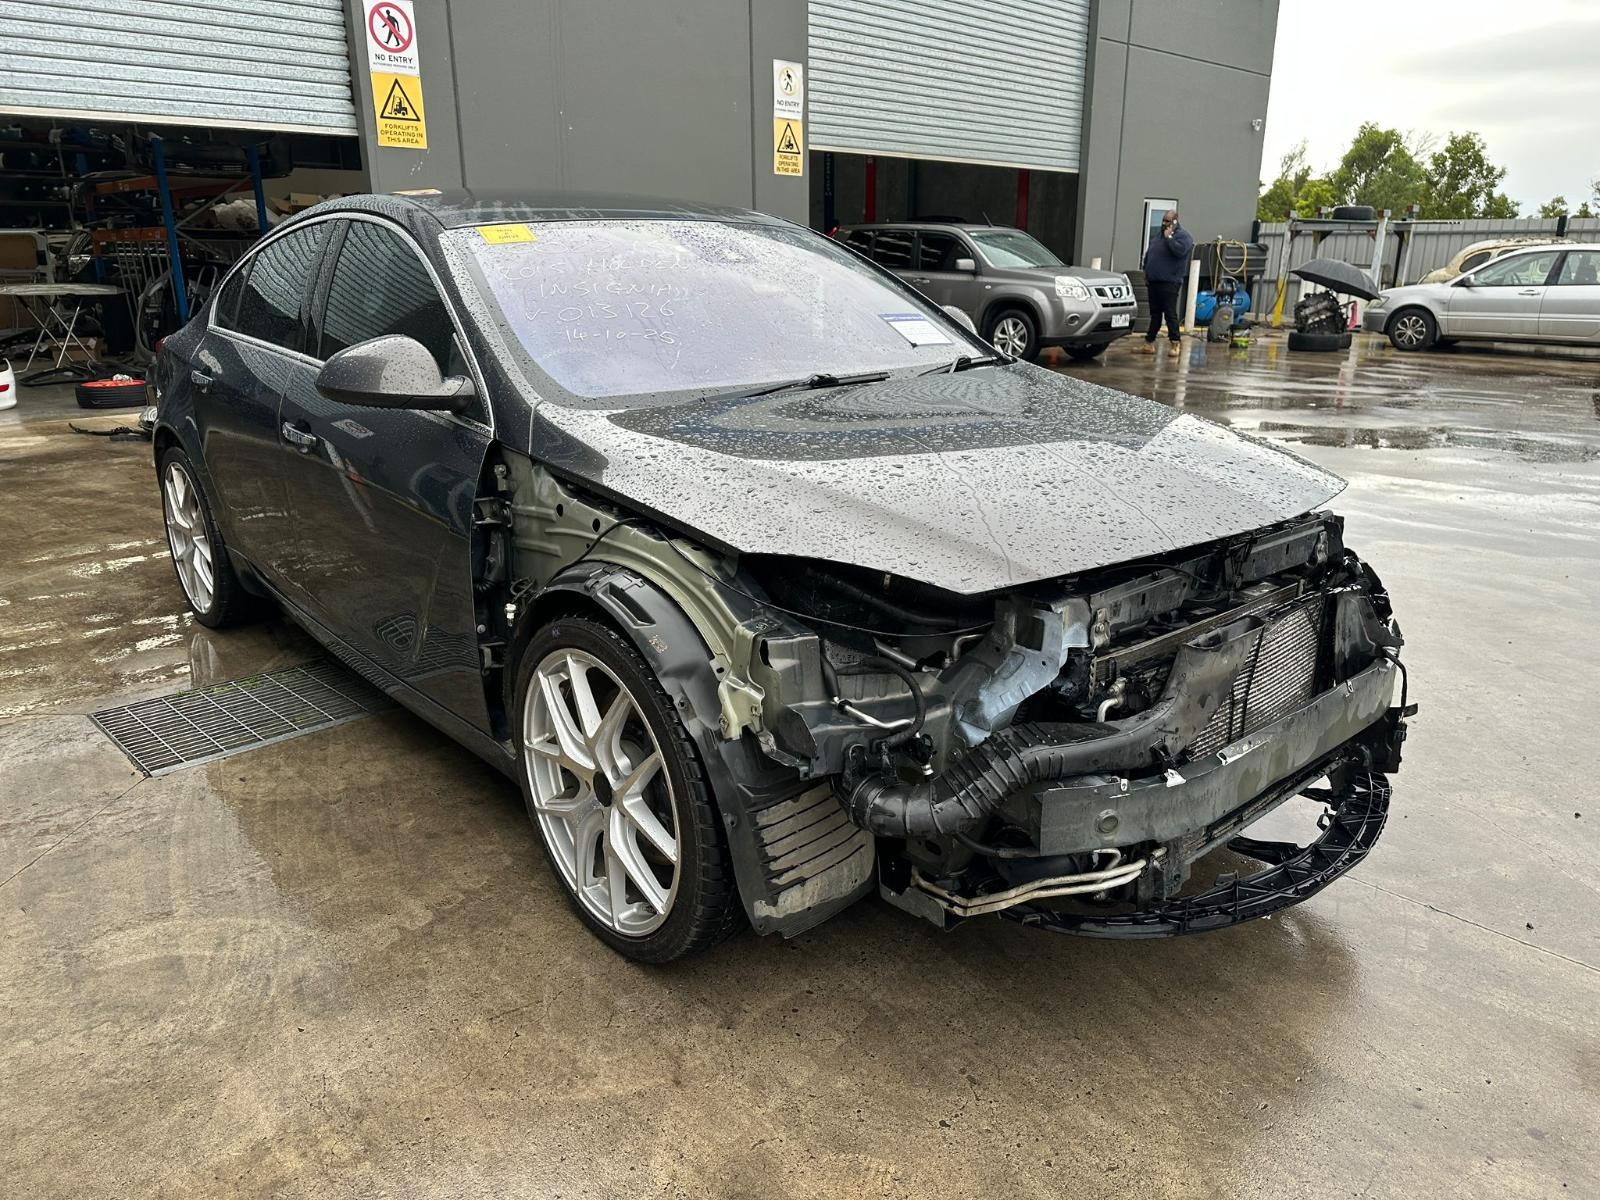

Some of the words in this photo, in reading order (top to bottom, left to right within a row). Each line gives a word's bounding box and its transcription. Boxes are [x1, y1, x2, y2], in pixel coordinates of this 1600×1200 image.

[374, 53, 386, 61] NO
[388, 54, 413, 64] ENTRY
[384, 123, 419, 131] FORKLIFTS
[380, 129, 416, 138] OPERATING
